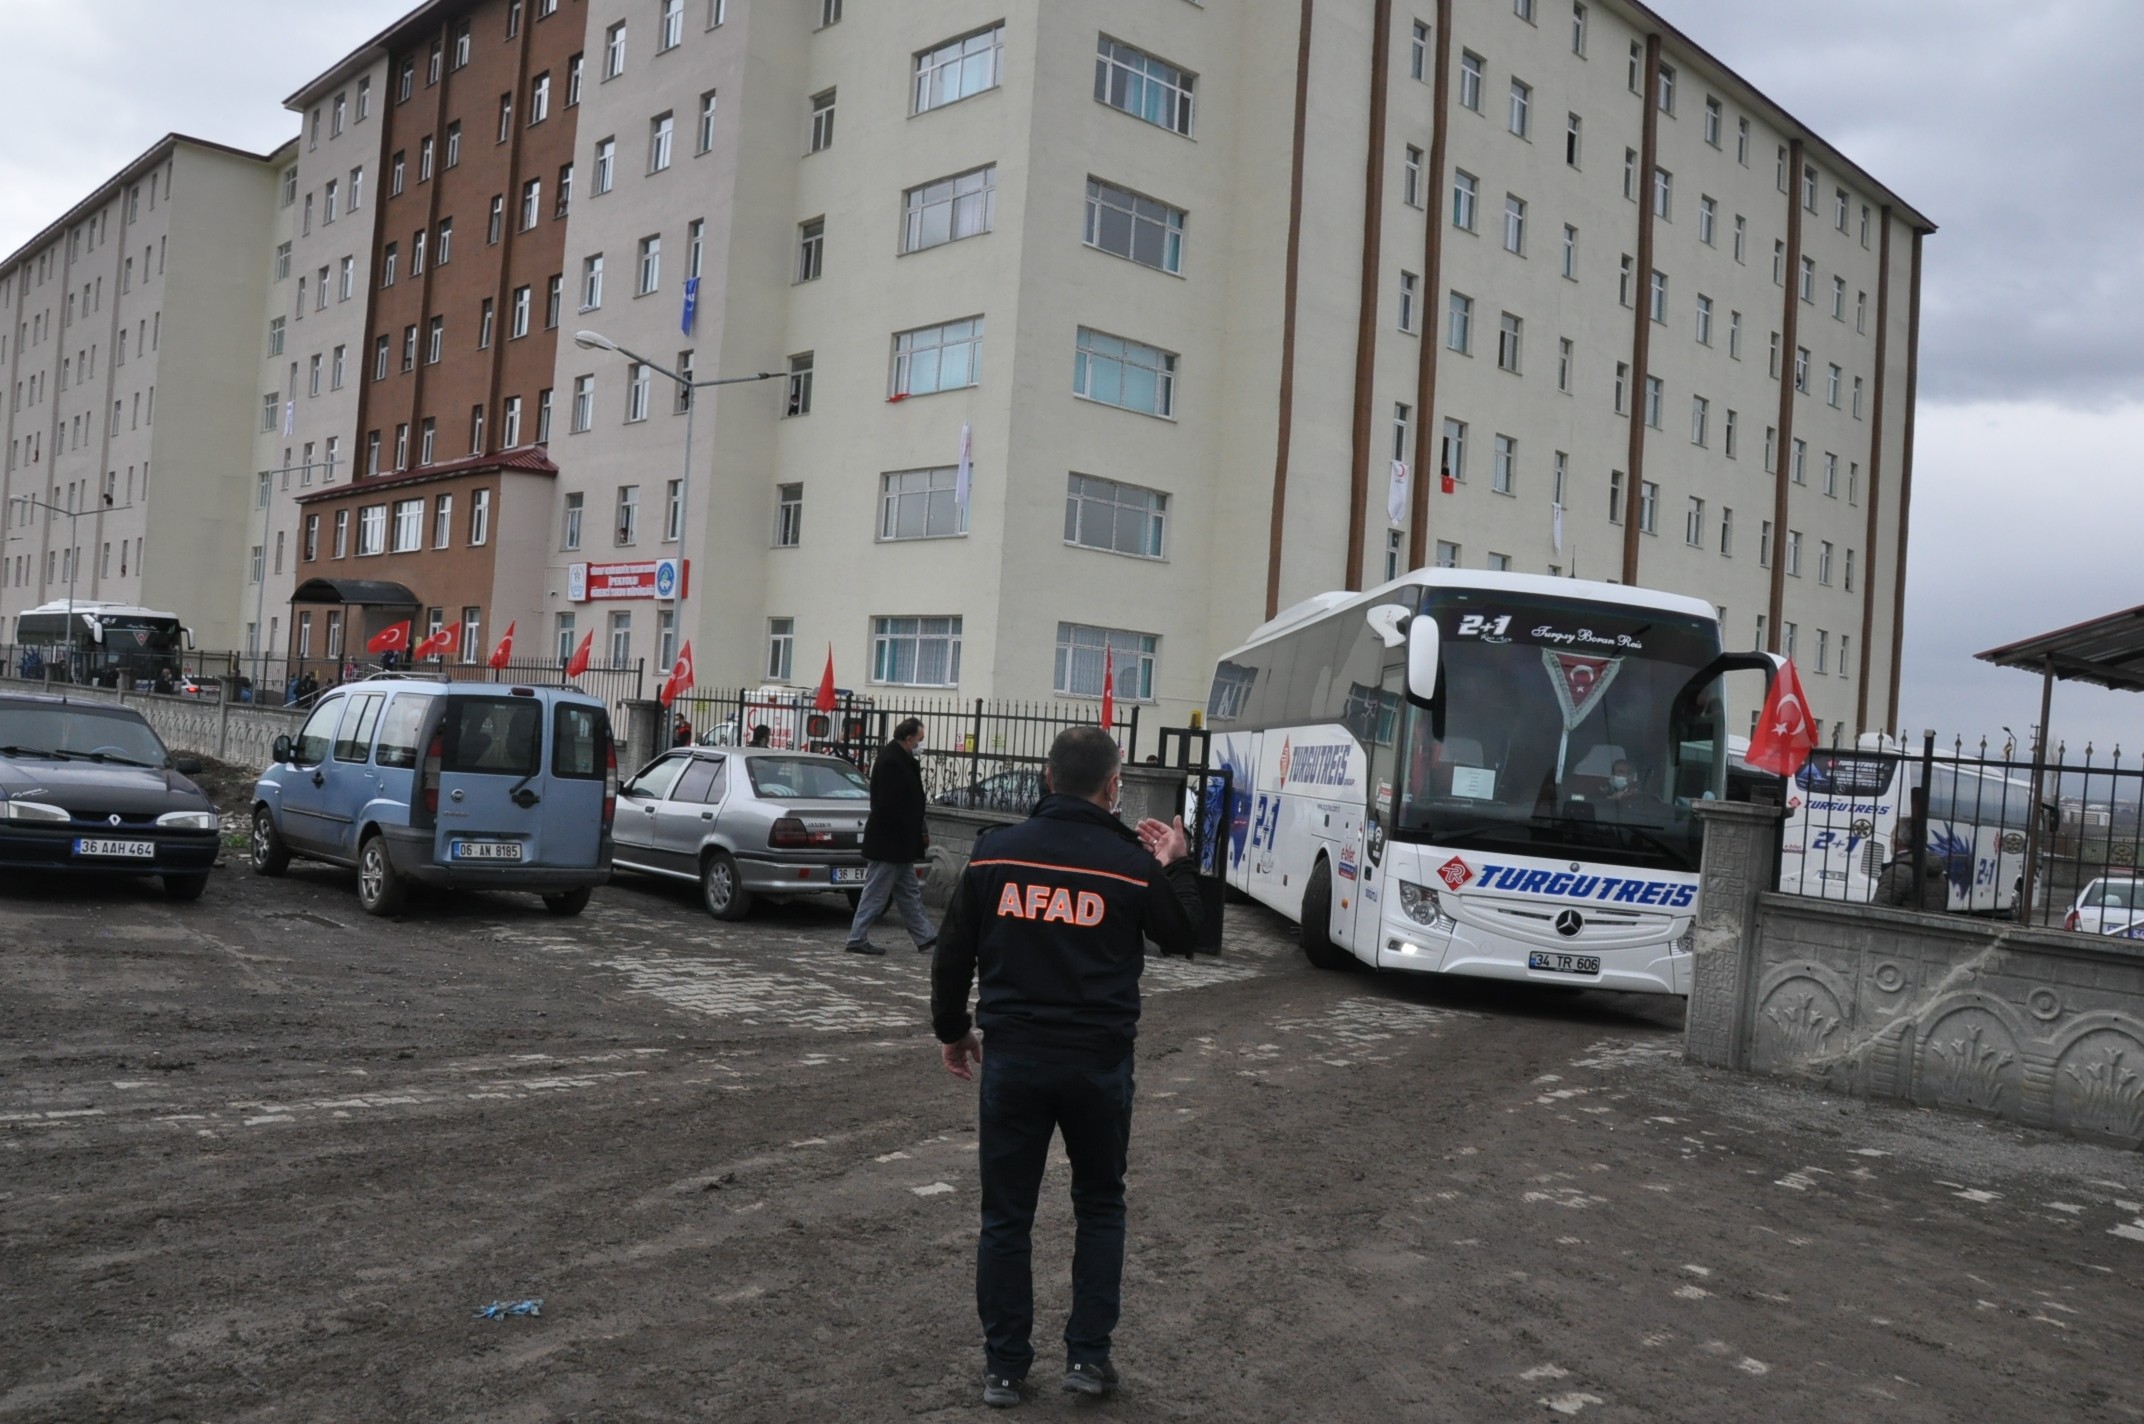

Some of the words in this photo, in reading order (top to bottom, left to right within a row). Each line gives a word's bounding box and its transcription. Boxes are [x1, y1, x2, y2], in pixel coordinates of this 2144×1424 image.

[1458, 614, 1512, 635] 2+1
[1577, 628, 1615, 645] Boran
[1617, 634, 1643, 649] Reis
[81, 840, 98, 853] 36
[101, 842, 126, 855] AAH
[128, 843, 152, 856] 464
[460, 844, 473, 856] 06
[479, 845, 491, 857] AN
[495, 845, 518, 857] 8185
[838, 868, 848, 880] 36
[997, 882, 1105, 926] AFAD
[1536, 954, 1550, 967] 34
[1556, 956, 1573, 968] TR
[1577, 958, 1598, 971] 606
